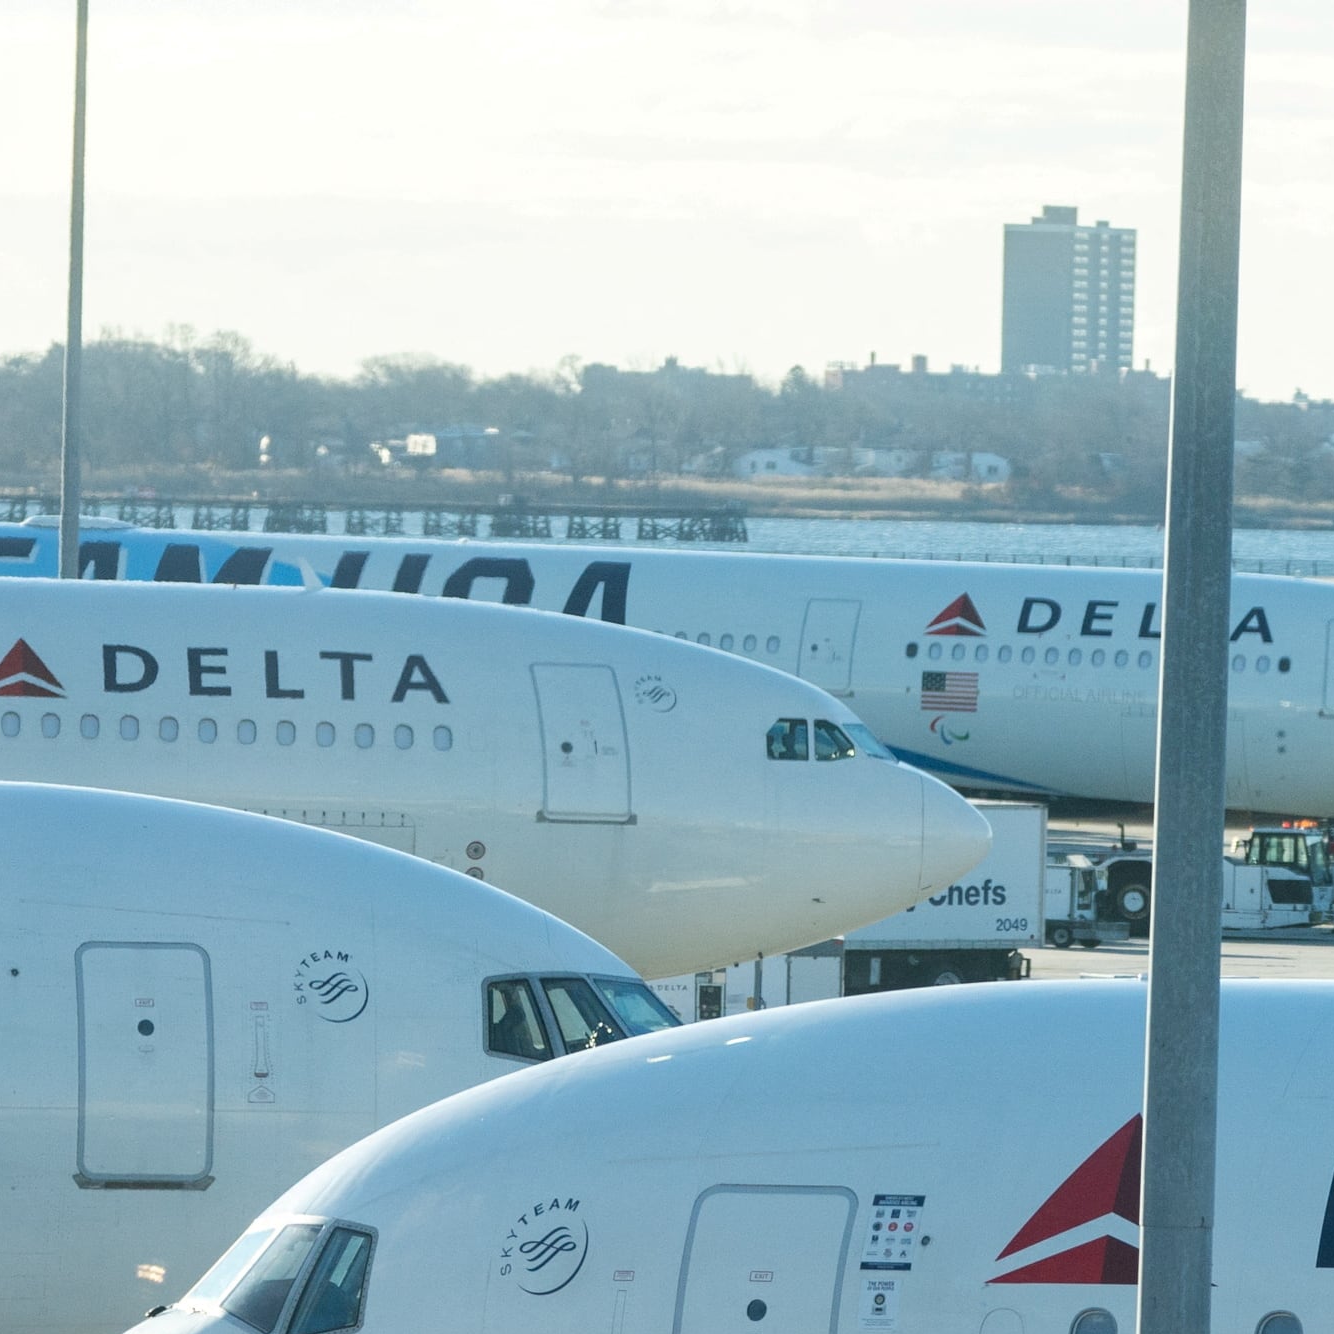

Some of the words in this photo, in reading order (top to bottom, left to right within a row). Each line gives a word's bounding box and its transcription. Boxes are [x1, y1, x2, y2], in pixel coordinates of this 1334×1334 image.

[1017, 597, 1273, 644] DELA
[102, 643, 451, 705] DELTA
[995, 918, 1028, 932] 2049
[293, 949, 350, 1005] SKYTEAM
[500, 1197, 581, 1277] SKYTEAM
